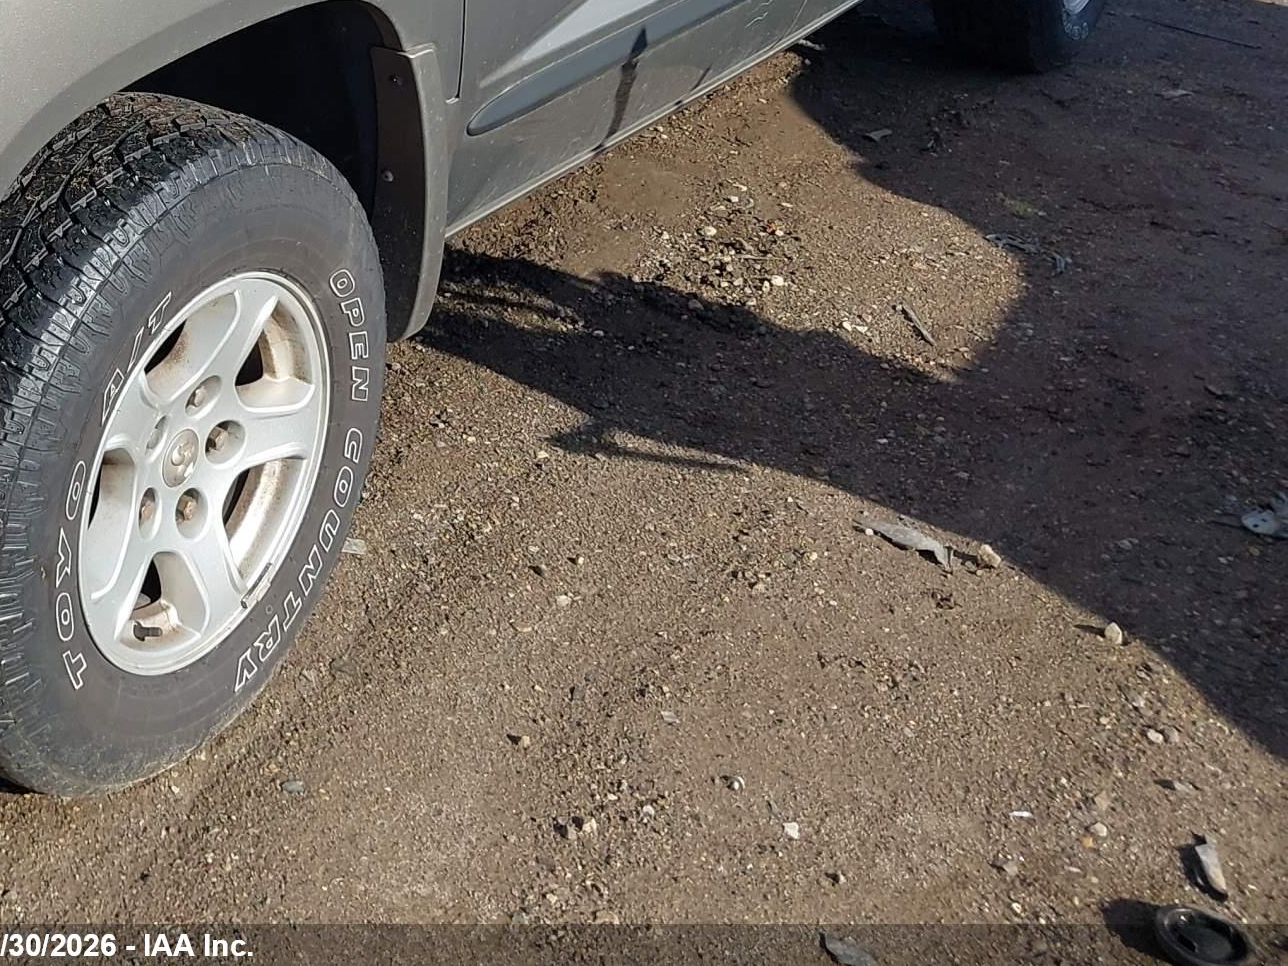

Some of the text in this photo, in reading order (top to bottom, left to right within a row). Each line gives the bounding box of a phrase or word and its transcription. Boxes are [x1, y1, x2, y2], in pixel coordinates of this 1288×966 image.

[56, 291, 172, 690] TOYO A/T
[234, 268, 370, 692] OPEN COUNTRY
